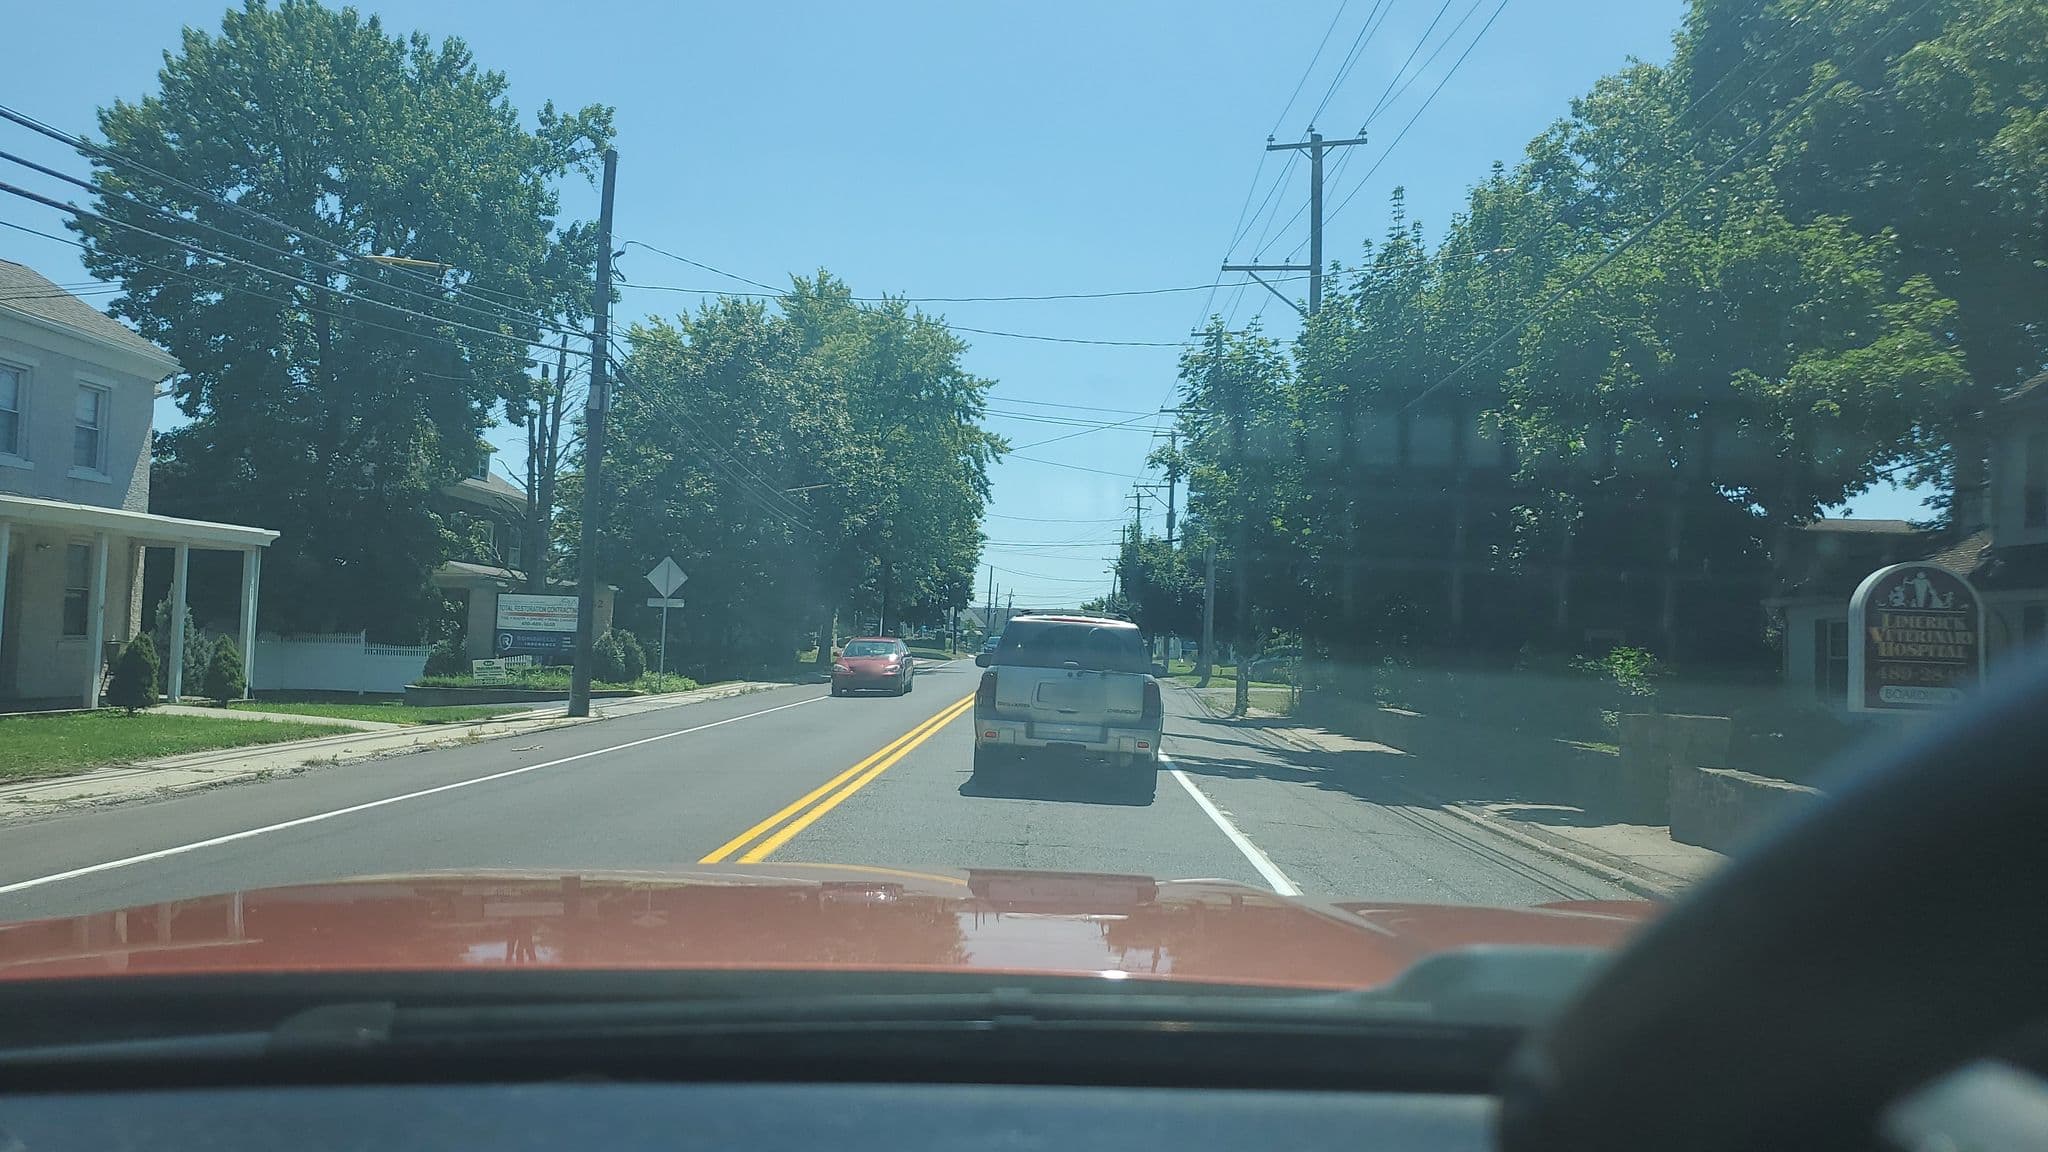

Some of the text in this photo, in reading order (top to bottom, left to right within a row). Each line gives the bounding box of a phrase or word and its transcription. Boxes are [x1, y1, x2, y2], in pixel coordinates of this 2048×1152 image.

[1881, 613, 1967, 630] LIMERICK
[1870, 627, 1973, 645] VETERINARY
[1877, 642, 1967, 658] HOSPITAL
